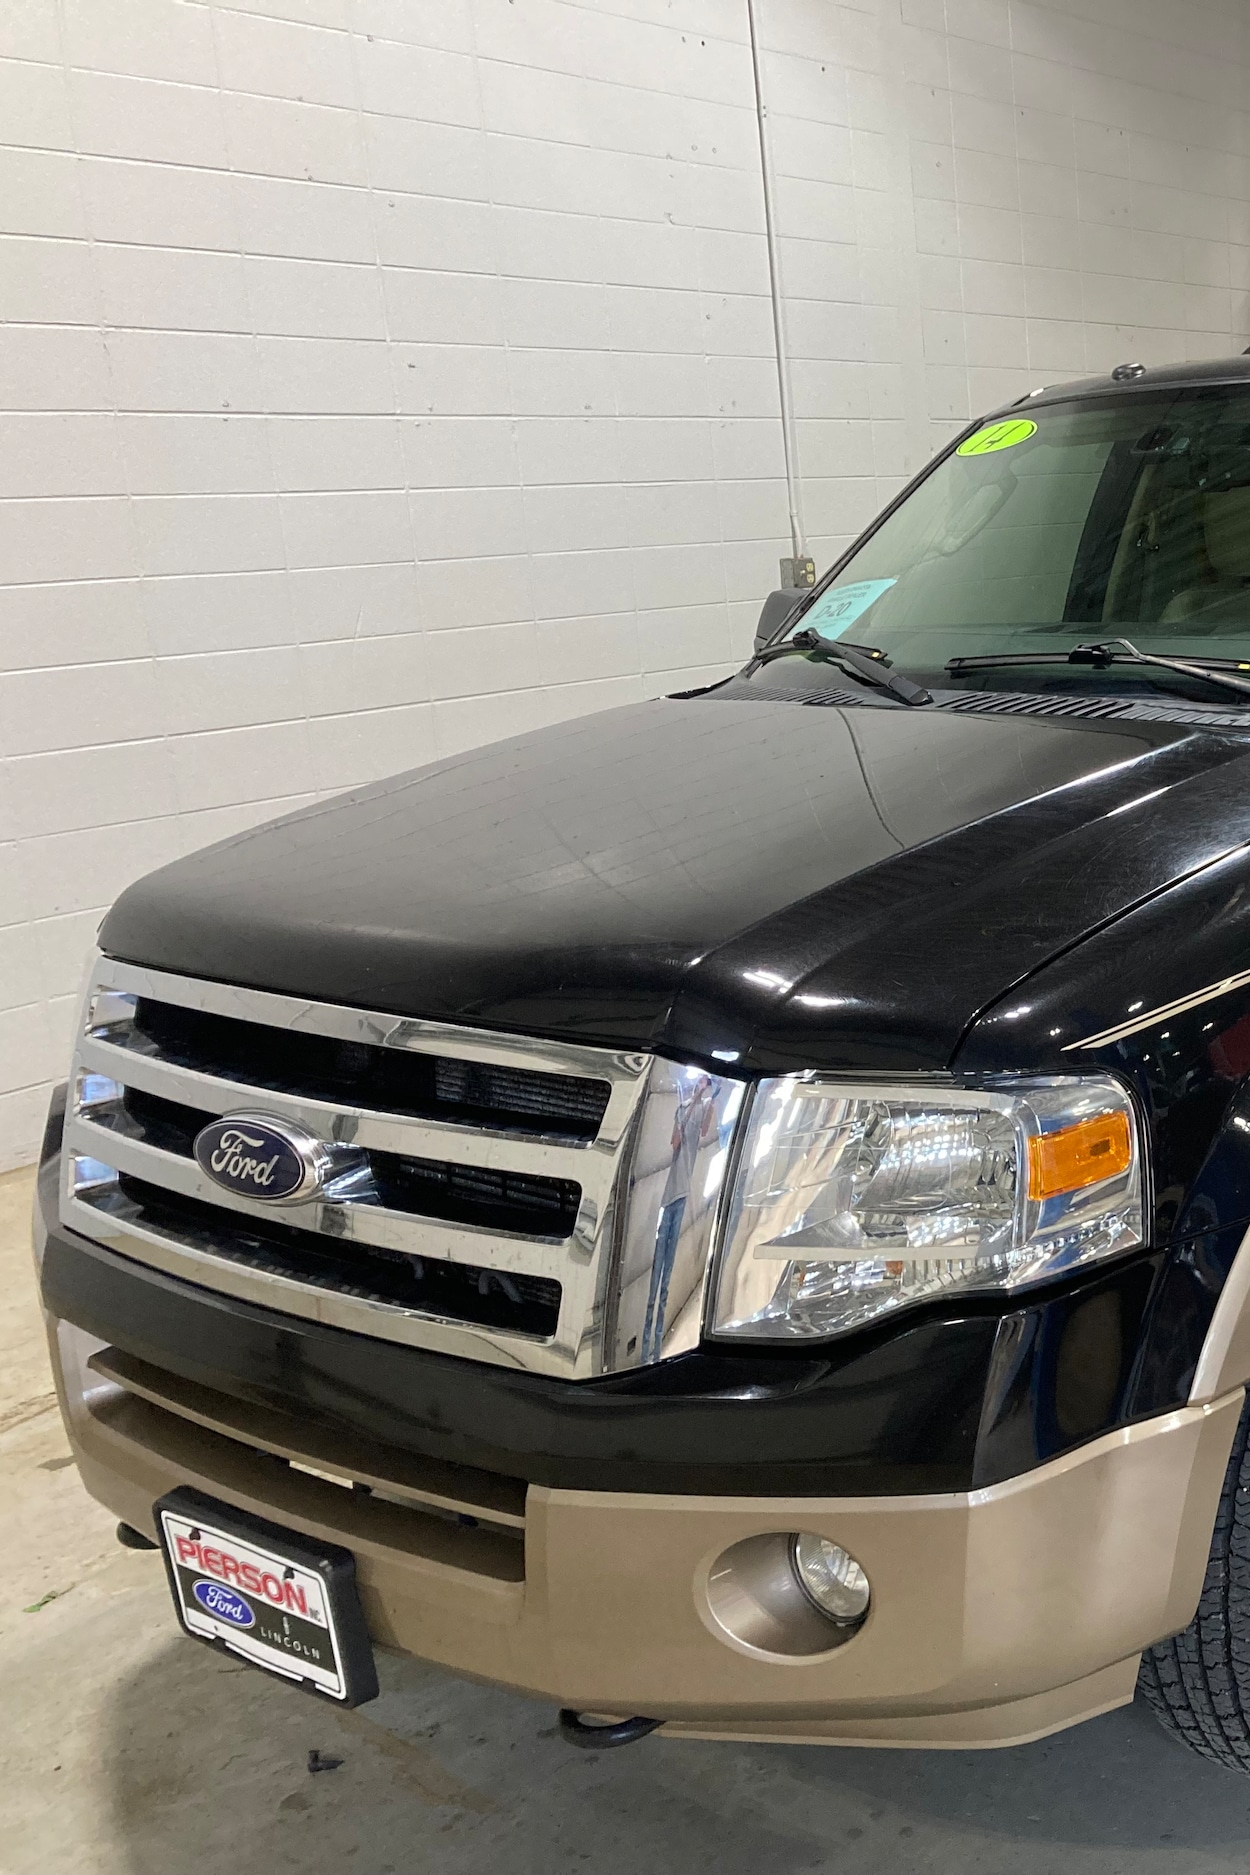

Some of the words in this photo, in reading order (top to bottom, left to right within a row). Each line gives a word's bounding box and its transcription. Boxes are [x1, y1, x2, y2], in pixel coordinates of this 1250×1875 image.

[210, 1130, 279, 1186] Ford
[174, 1534, 309, 1616] PIERSON
[205, 1586, 244, 1620] Ford
[260, 1626, 320, 1660] LINCOLN
